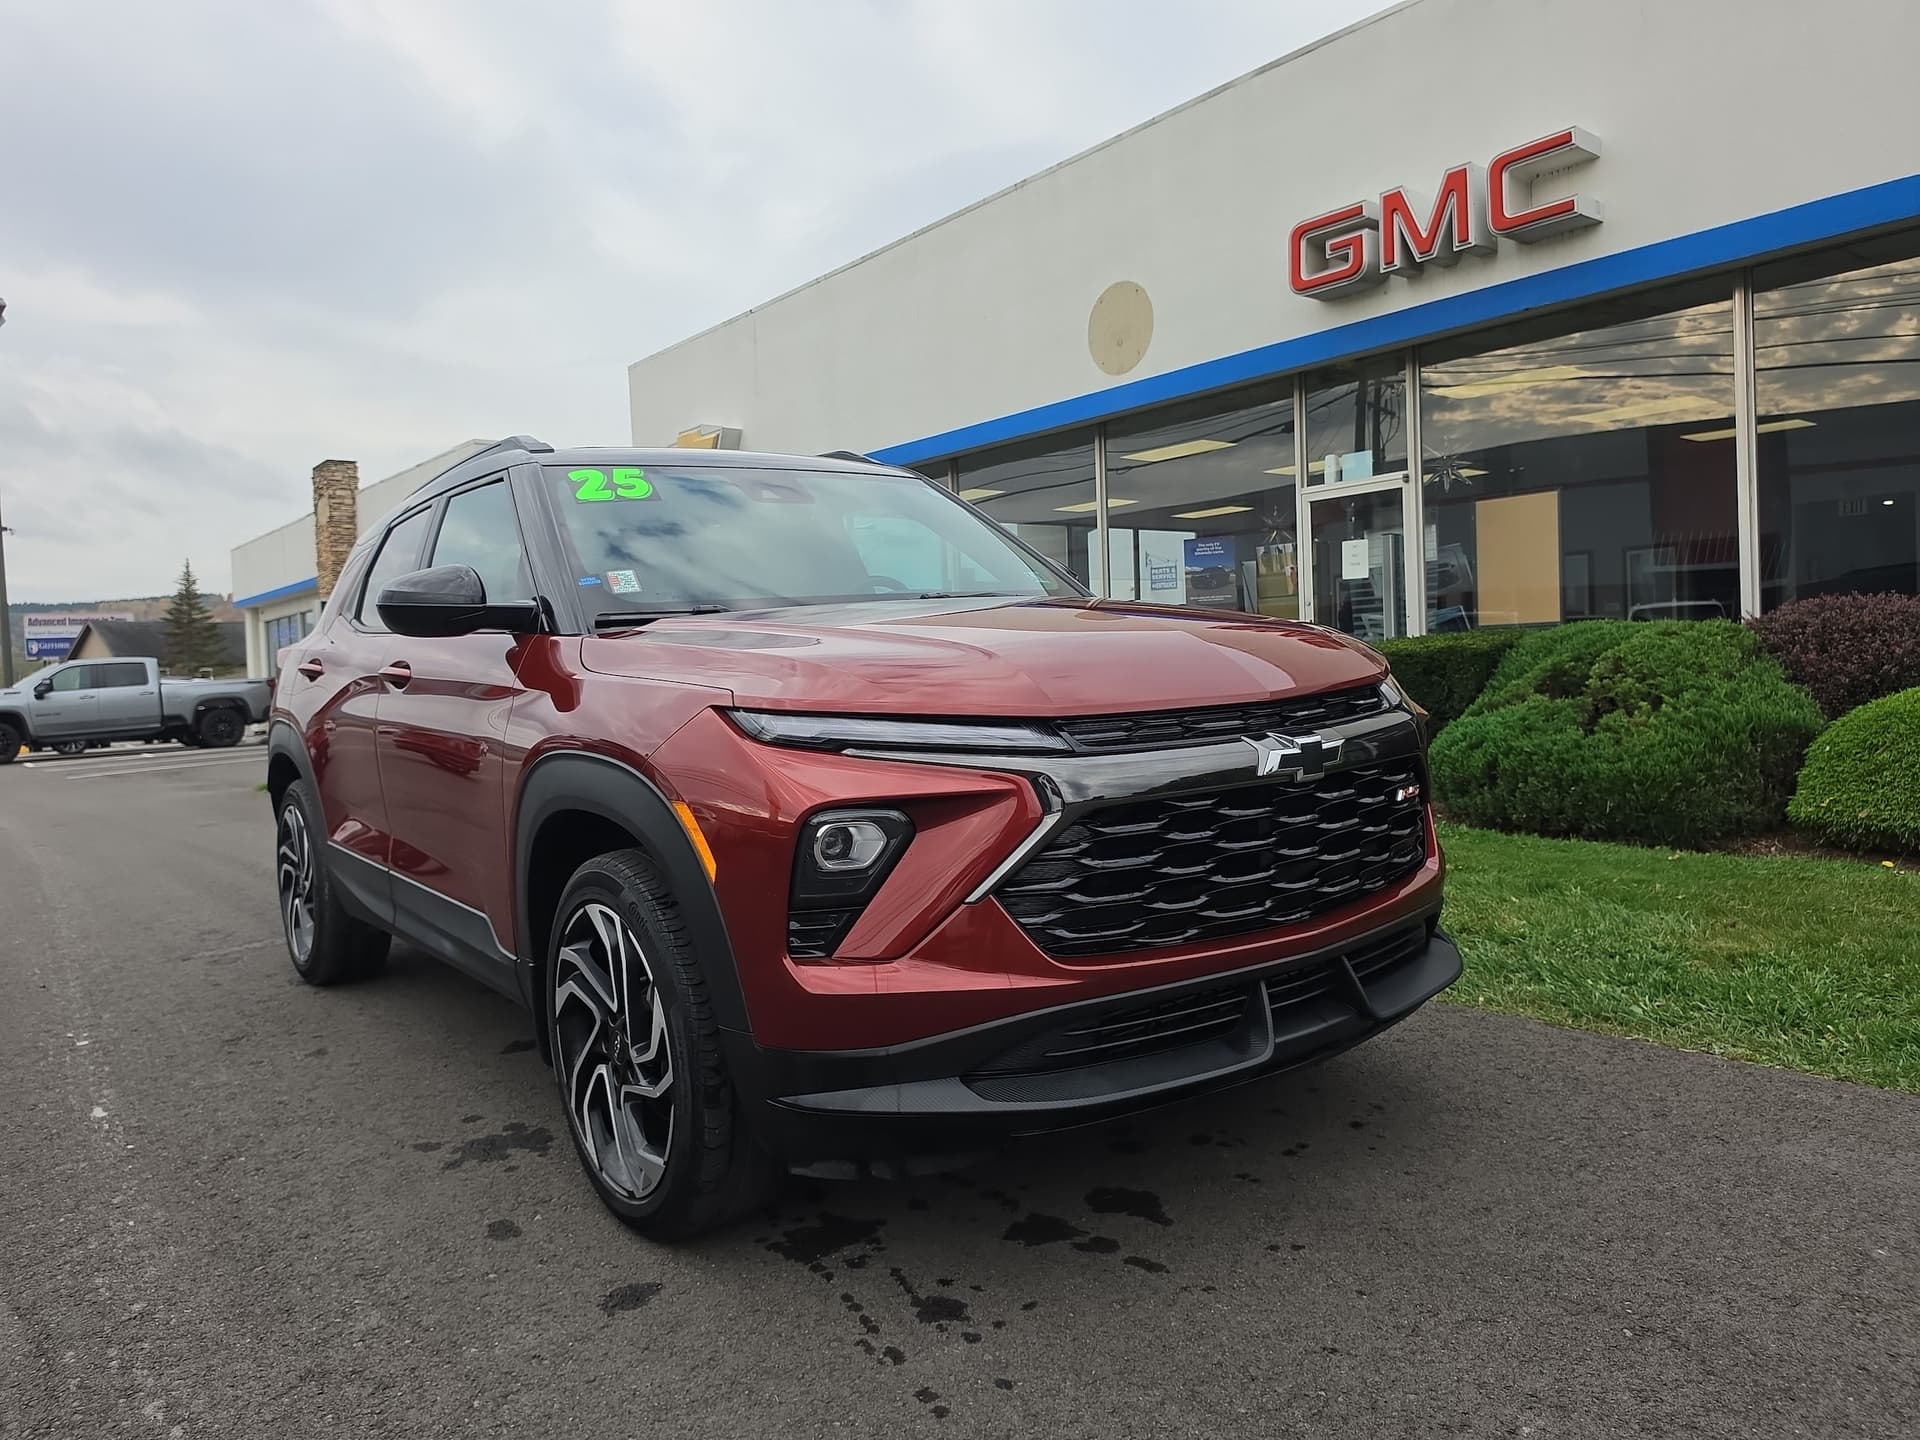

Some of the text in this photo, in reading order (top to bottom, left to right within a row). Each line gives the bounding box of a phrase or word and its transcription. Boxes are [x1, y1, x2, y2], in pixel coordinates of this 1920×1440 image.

[1289, 126, 1602, 300] GMC
[568, 468, 653, 502] 25
[28, 617, 66, 626] Advanced
[1397, 784, 1420, 802] RS
